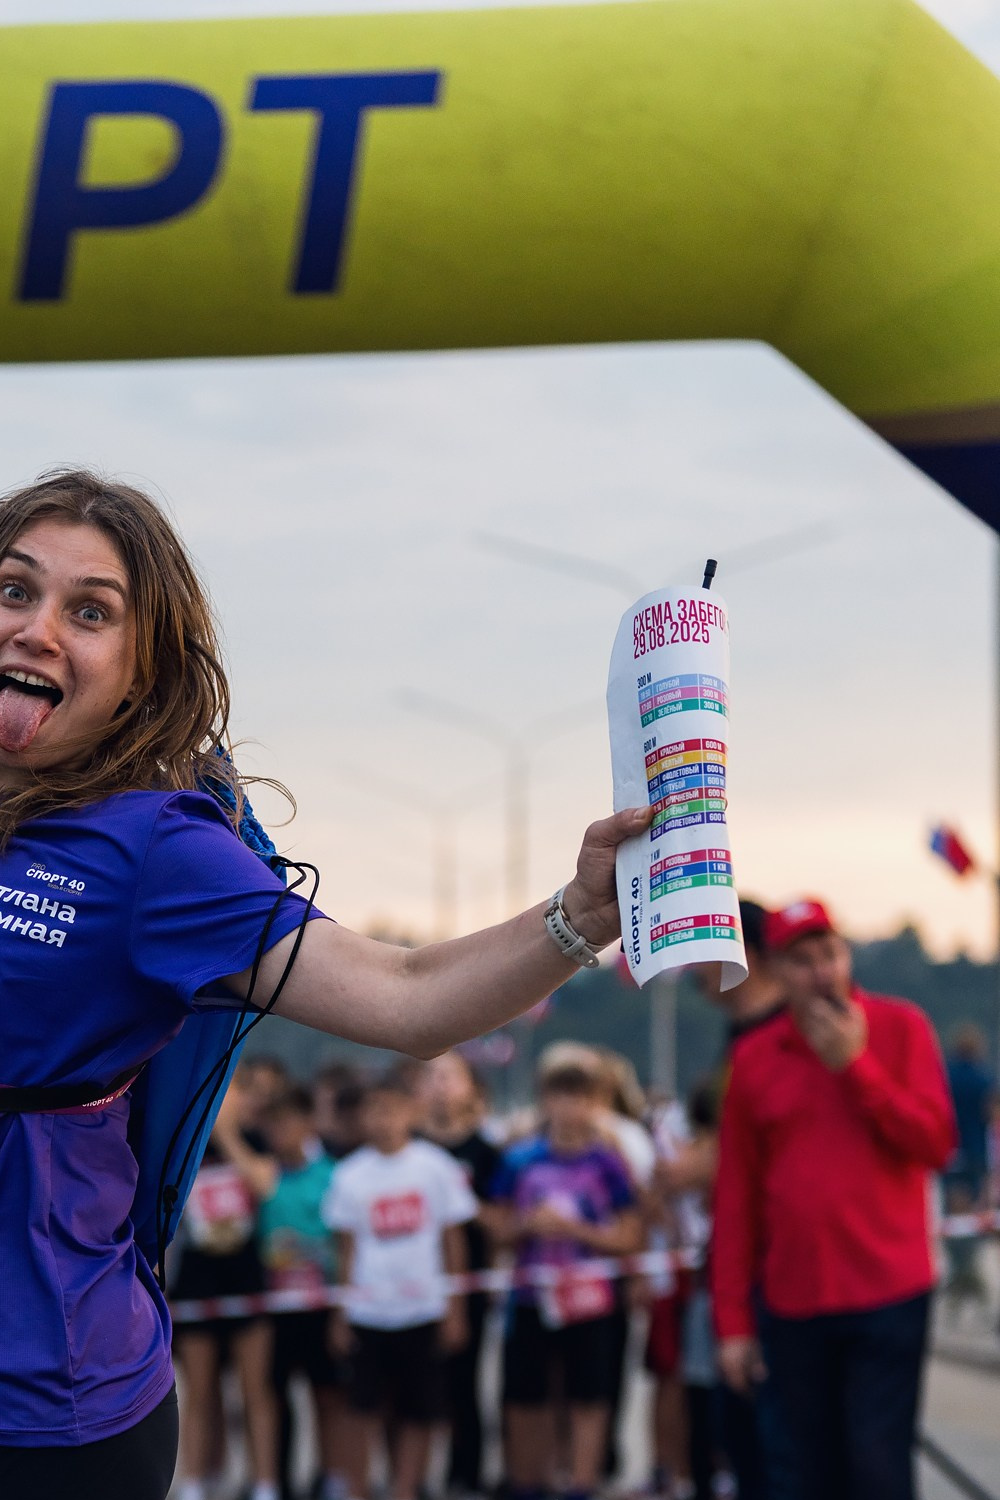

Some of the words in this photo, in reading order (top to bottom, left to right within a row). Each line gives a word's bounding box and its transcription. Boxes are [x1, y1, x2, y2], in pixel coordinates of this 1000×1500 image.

[633, 601, 673, 637] СХЕМА
[677, 599, 729, 634] ЗАБЕГО
[633, 620, 710, 659] 29.08.2025
[657, 689, 681, 705] РОЗОВЫЙ
[703, 689, 713, 698] 300
[703, 701, 714, 709] 300
[660, 742, 685, 757] КРАСНЫЙ
[705, 740, 717, 749] 600
[662, 764, 699, 781] ФИОЛЕТОВЫЙ
[707, 765, 718, 773] 600
[707, 777, 719, 785] 600
[708, 789, 720, 797] 600
[708, 801, 721, 809] 600
[665, 813, 702, 830] ФИОЛЕТОВЫЙ
[709, 813, 721, 821] 600
[716, 850, 726, 859] КМ
[31, 862, 46, 871] PRO
[717, 863, 727, 872] КМ
[26, 868, 68, 886] СПОРТ
[68, 879, 86, 892] 40
[631, 877, 639, 899] 40
[667, 918, 694, 932] КРАСНЫЙ
[714, 916, 720, 924] 2
[720, 916, 730, 925] КМ
[715, 928, 720, 936] 2
[720, 928, 730, 936] КМ
[631, 904, 641, 965] СПОРТ
